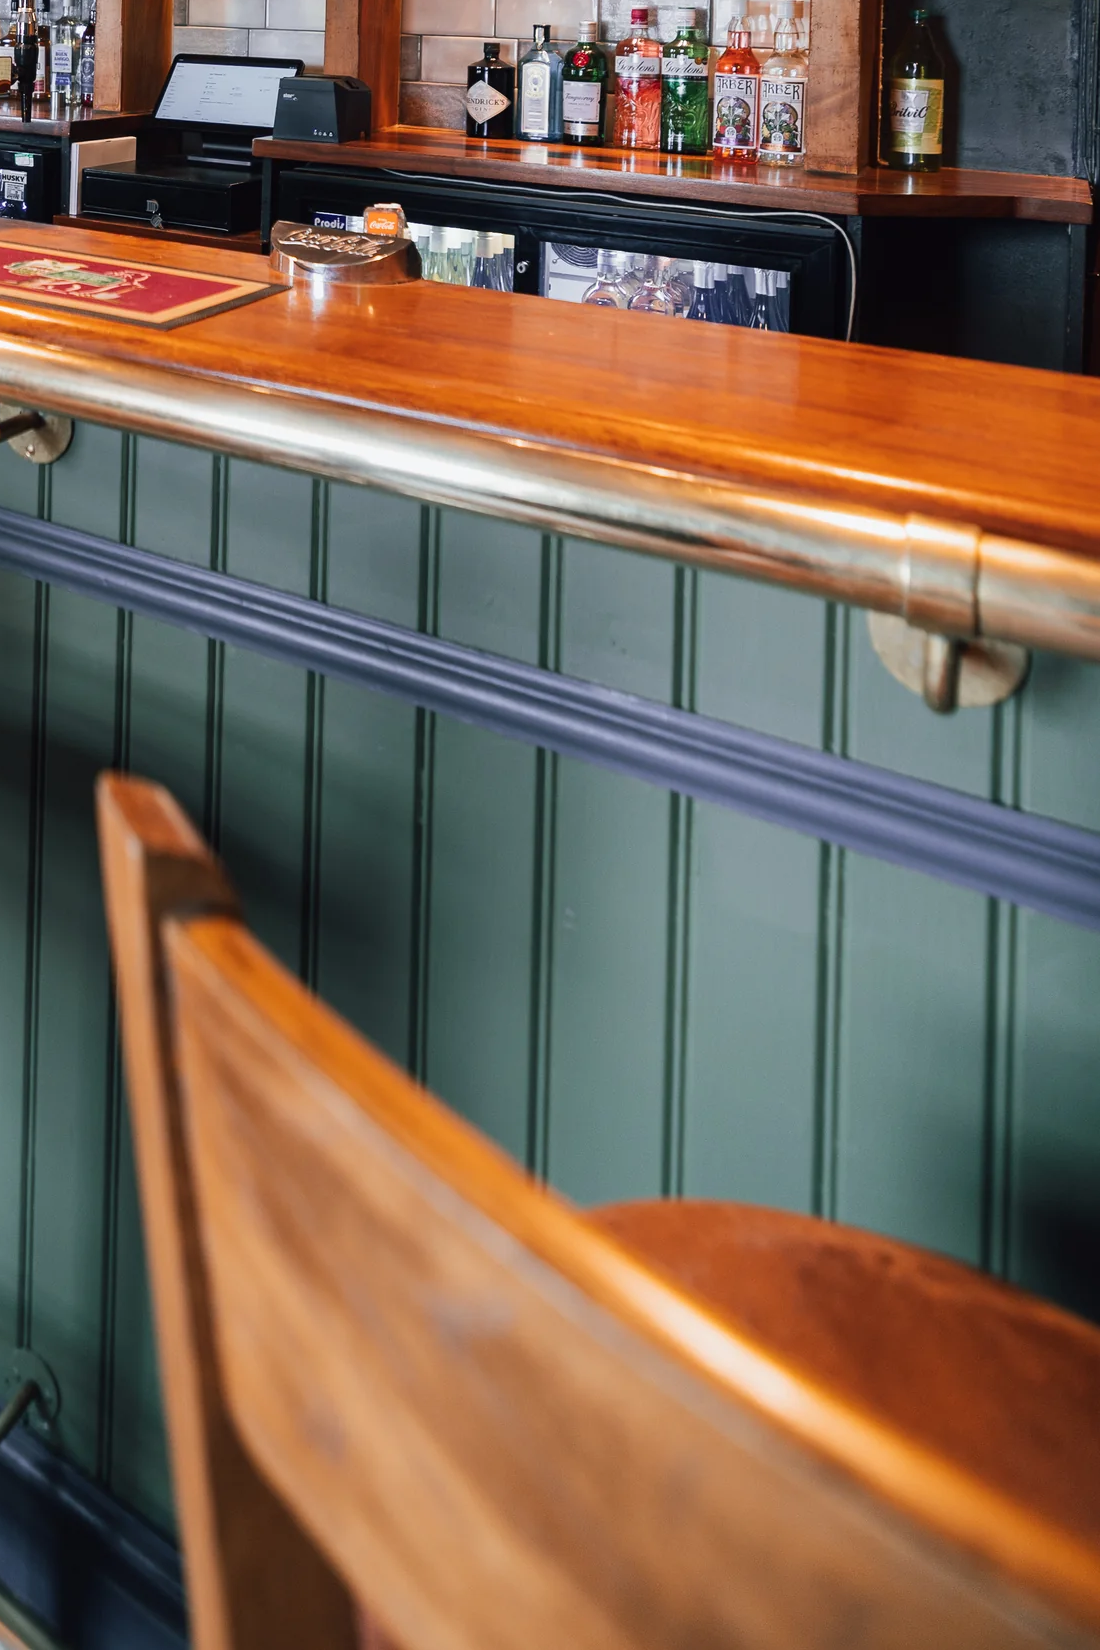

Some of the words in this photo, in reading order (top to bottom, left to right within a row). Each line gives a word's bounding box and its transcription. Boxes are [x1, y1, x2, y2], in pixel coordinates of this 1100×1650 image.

[618, 59, 656, 72] Gordon's
[665, 60, 704, 74] Gordon's
[716, 75, 753, 95] ARBER
[762, 83, 800, 100] ARBER
[467, 97, 506, 106] ENDRICK'S
[1, 172, 26, 183] HUSKY
[314, 216, 346, 230] Prodis
